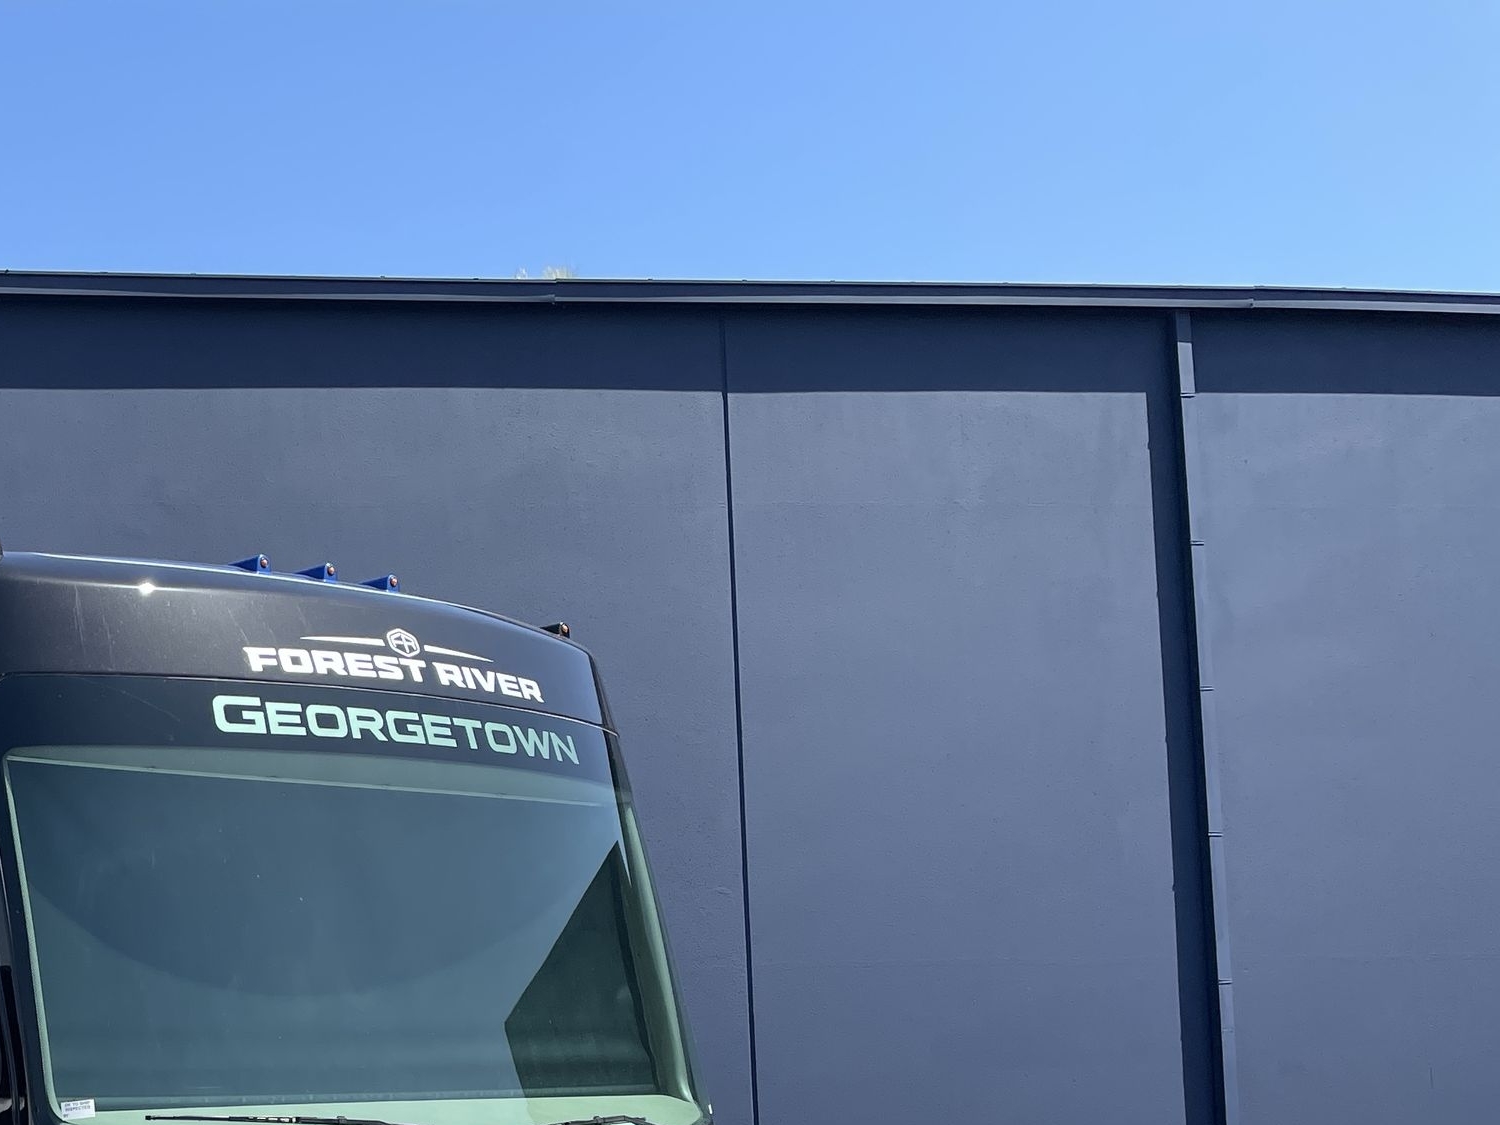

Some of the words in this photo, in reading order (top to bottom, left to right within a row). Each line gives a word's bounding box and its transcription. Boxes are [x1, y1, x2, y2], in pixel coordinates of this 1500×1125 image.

[243, 646, 426, 683] FOREST
[432, 661, 545, 703] RIVER
[212, 694, 580, 765] GEORGETOWN
